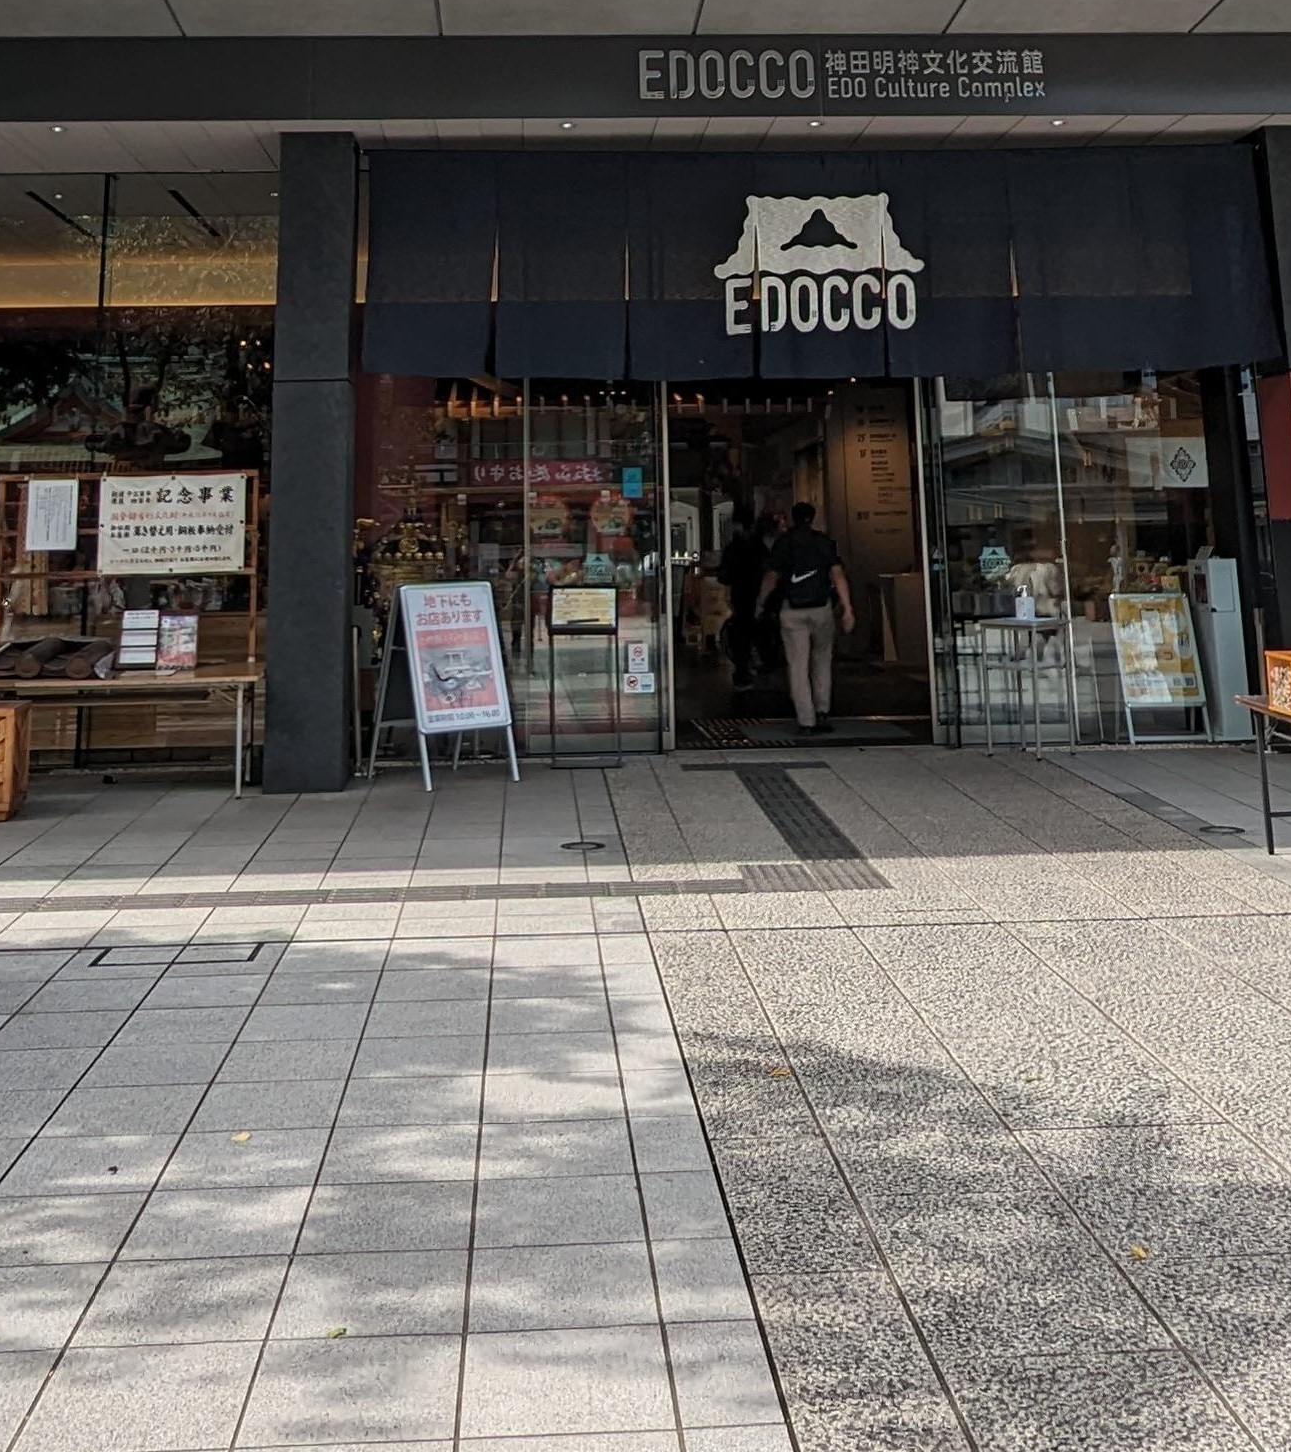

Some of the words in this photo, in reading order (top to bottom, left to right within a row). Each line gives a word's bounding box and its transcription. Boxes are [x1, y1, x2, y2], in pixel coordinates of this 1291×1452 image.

[638, 49, 815, 100] EDOCCO
[825, 49, 1045, 76] 神田明神文化交流館
[827, 77, 867, 99] EDO
[875, 76, 951, 99] Culture
[957, 76, 1046, 103] Complex
[725, 272, 917, 336] EDOCCO
[156, 486, 234, 504] 記念事業
